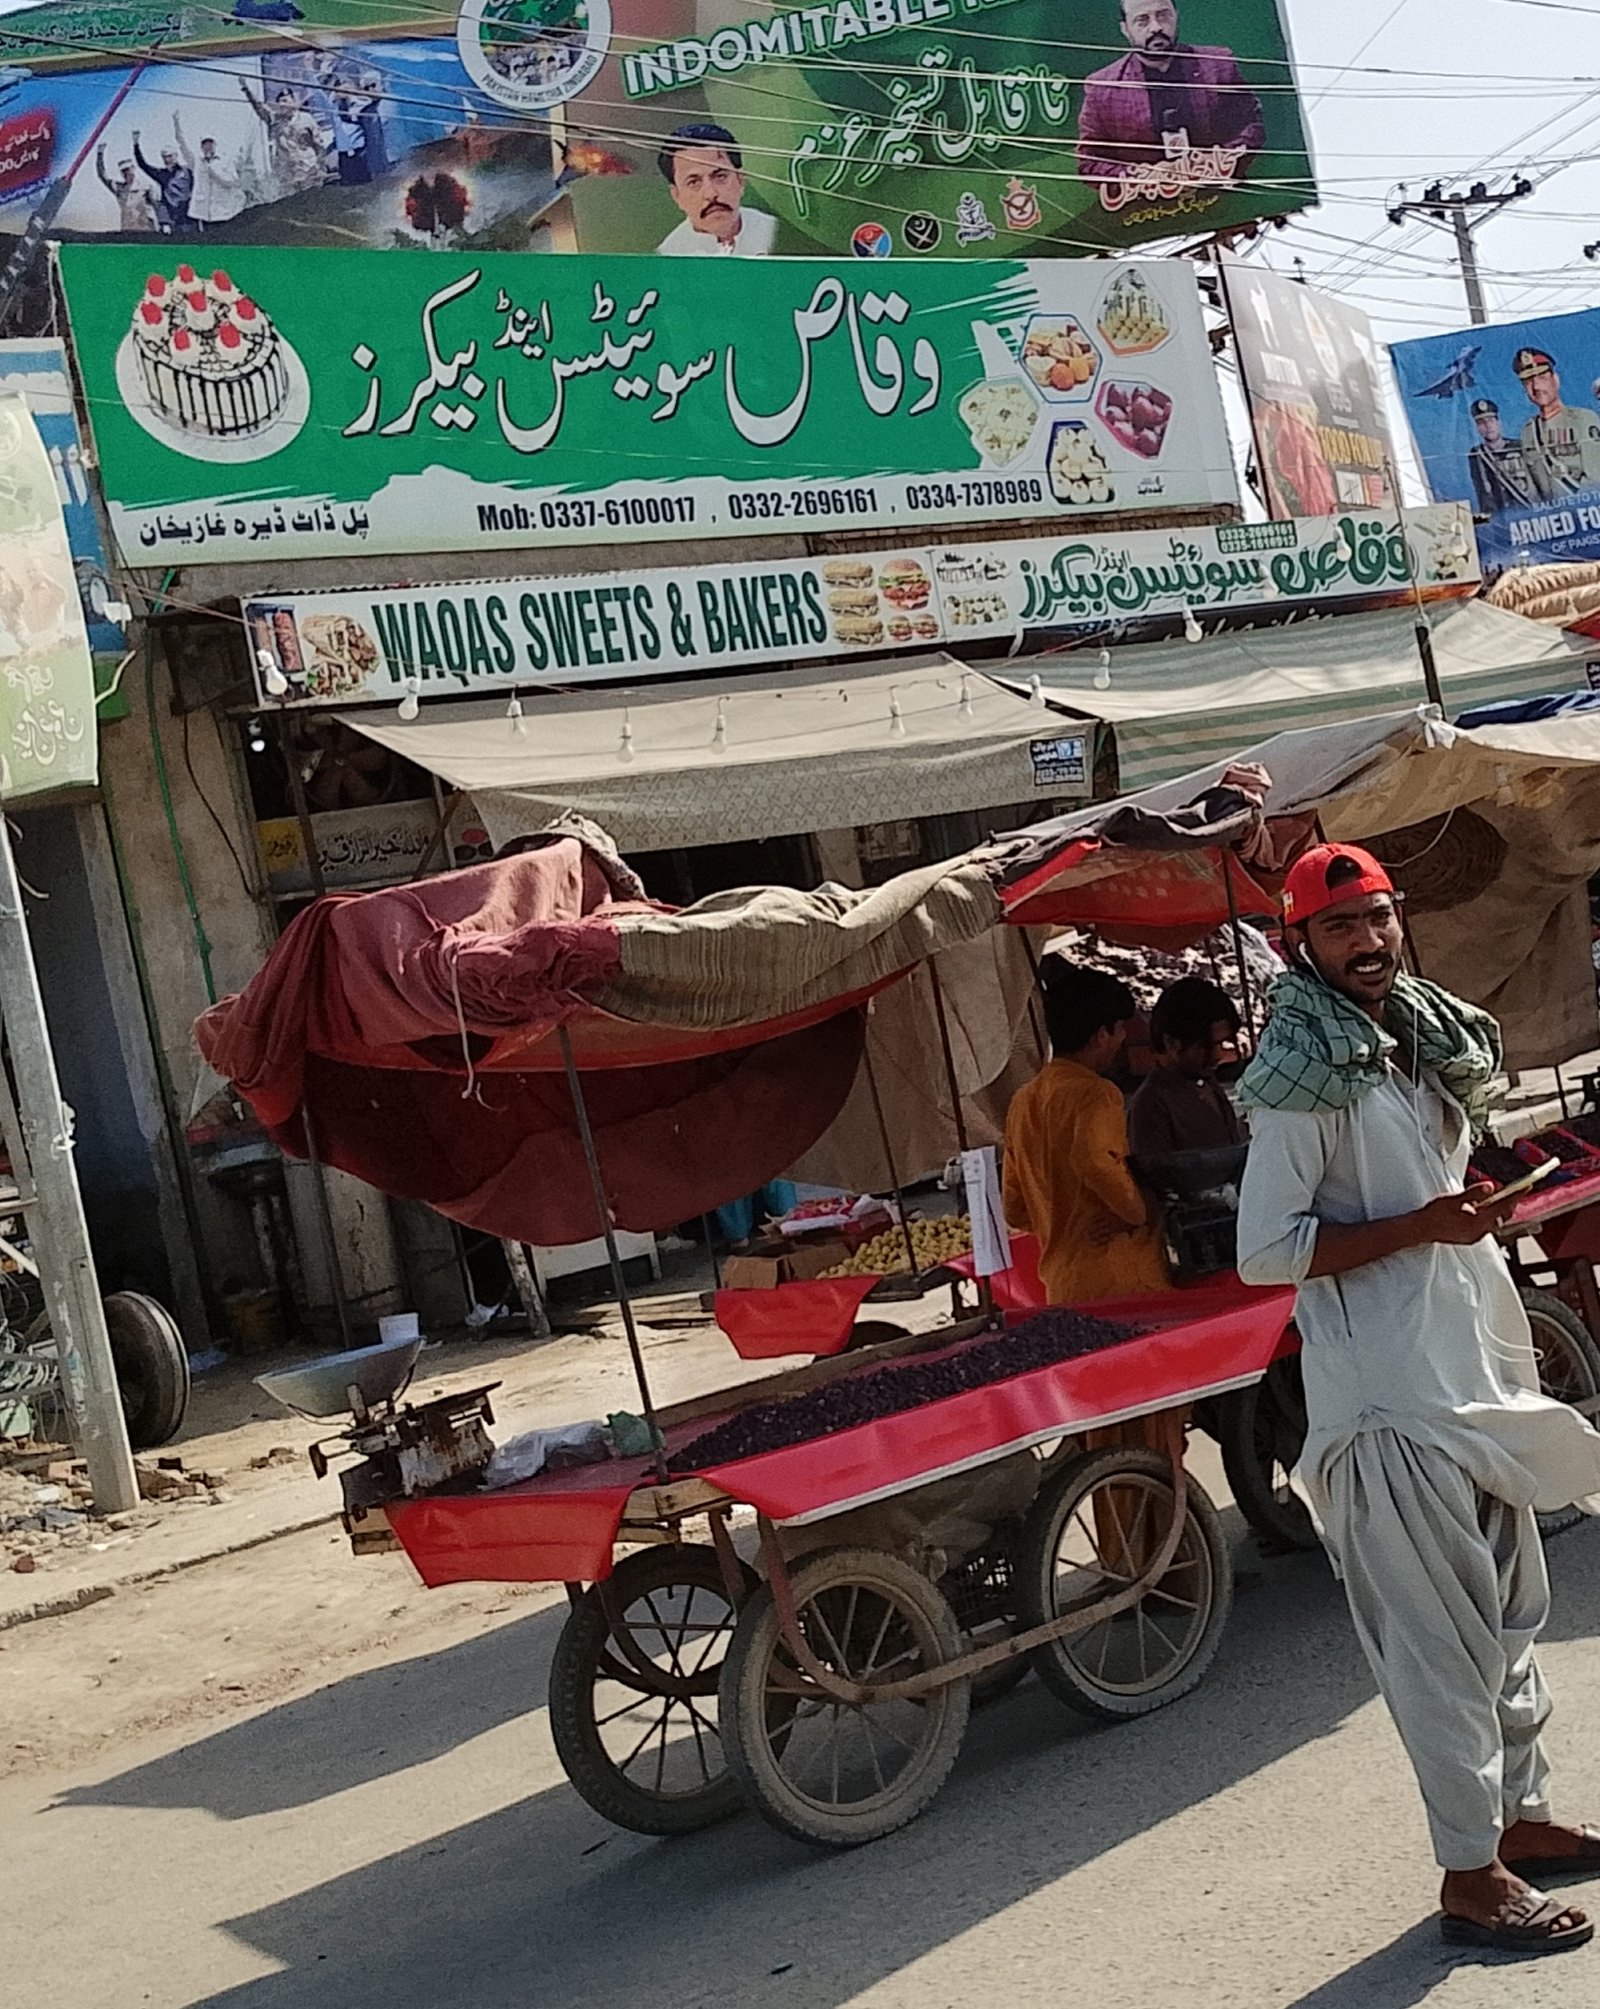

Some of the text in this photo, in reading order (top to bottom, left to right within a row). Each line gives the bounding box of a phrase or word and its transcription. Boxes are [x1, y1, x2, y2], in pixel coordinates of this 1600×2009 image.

[625, 0, 949, 94] INDOMITABLE
[342, 267, 483, 439] بیکرز
[493, 288, 552, 359] اینڈ
[724, 275, 943, 449] وقاص
[234, 503, 287, 540] ڈیرہ
[477, 503, 537, 532] Mob:
[539, 496, 696, 529] 0337-6100017
[728, 488, 878, 520] 0332-2696161
[906, 479, 1043, 511] 0334-7378989
[1218, 522, 1294, 541] 0332-2696161
[1509, 505, 1600, 546] ARMED FO
[1532, 496, 1576, 513] SALUTE
[1551, 533, 1600, 554] OF PAKIS
[1019, 543, 1104, 619] بیکرز
[372, 571, 829, 687] WAQAS SWEETS & BAKERS
